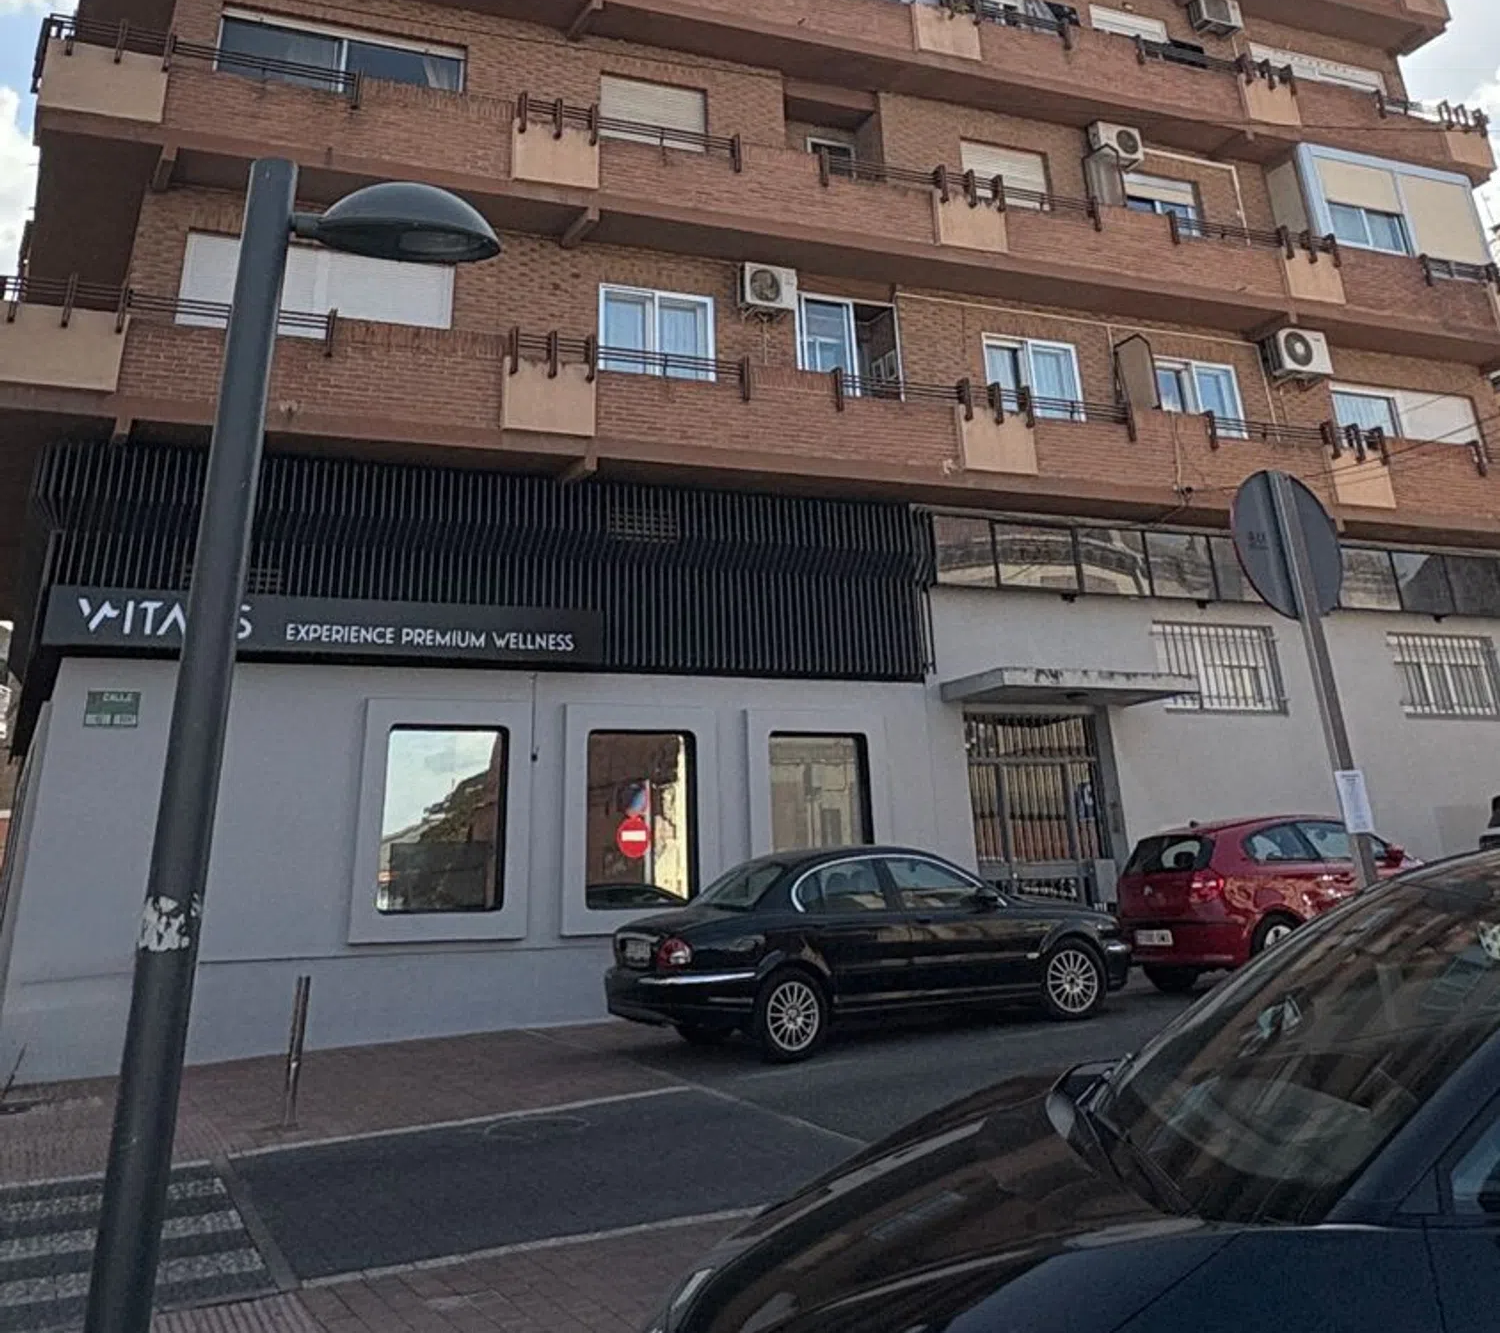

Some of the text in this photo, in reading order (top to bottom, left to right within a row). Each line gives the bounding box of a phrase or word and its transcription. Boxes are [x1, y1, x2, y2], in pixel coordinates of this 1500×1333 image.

[78, 597, 253, 640] VITAS
[286, 623, 575, 651] EXPERIENCE PREMIUM WELLNESS
